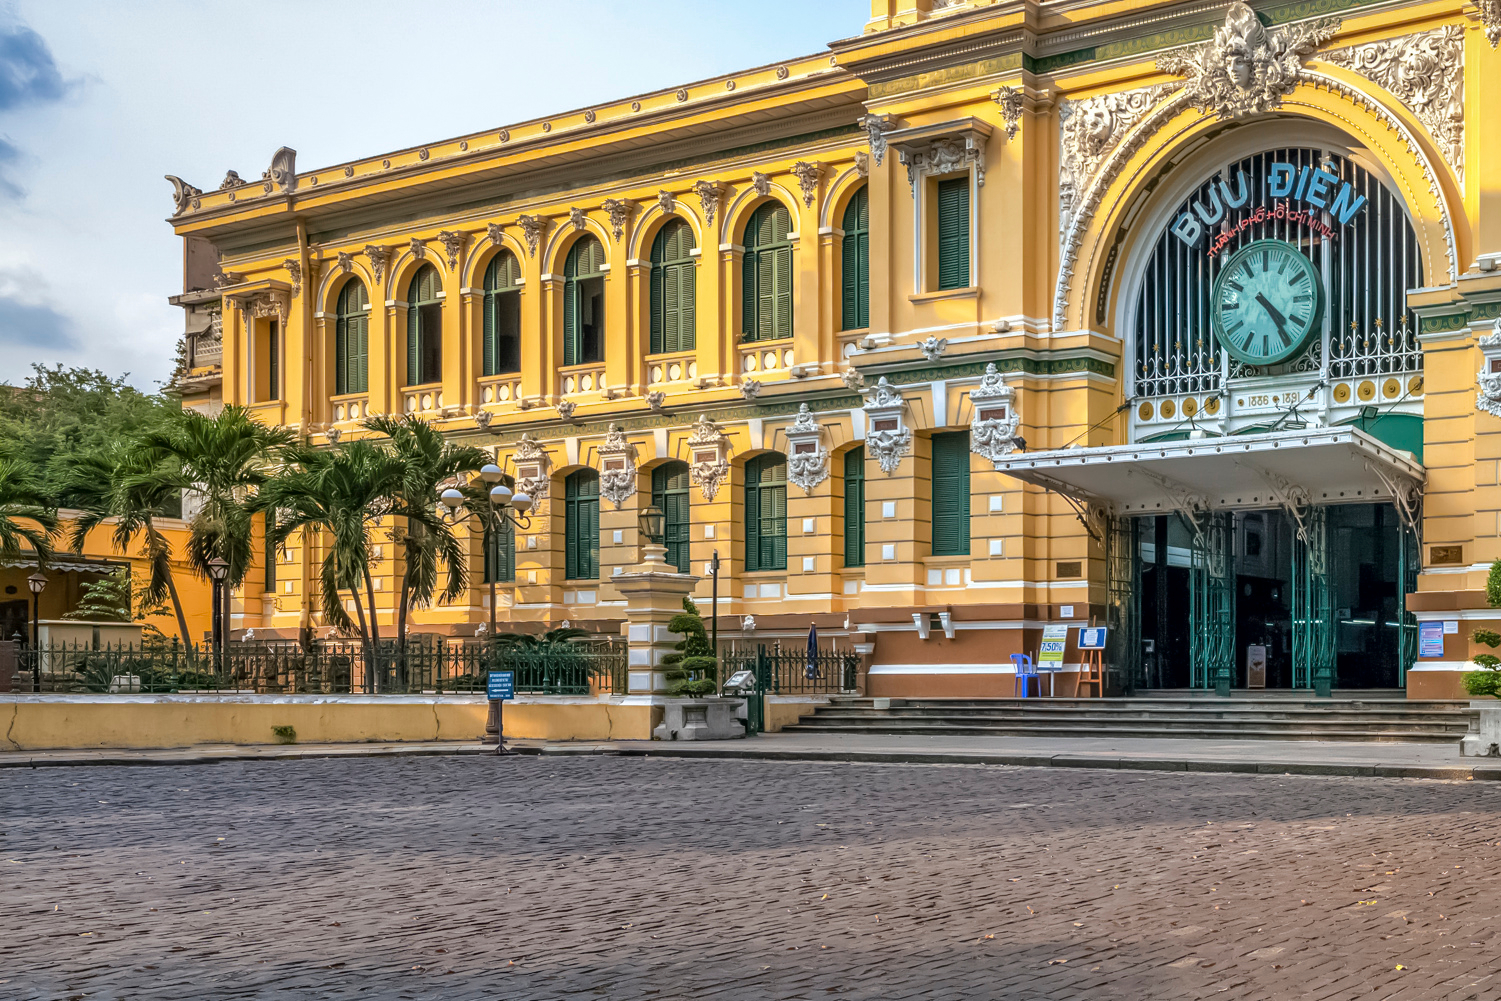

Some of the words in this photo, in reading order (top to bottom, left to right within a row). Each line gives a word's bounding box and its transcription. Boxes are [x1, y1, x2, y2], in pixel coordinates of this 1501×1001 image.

[1268, 161, 1366, 225] ĐIỆN
[1207, 224, 1241, 258] THÀNH
[1307, 215, 1338, 241] MINH
[1248, 395, 1269, 407] 1886
[1282, 391, 1300, 404] 1891
